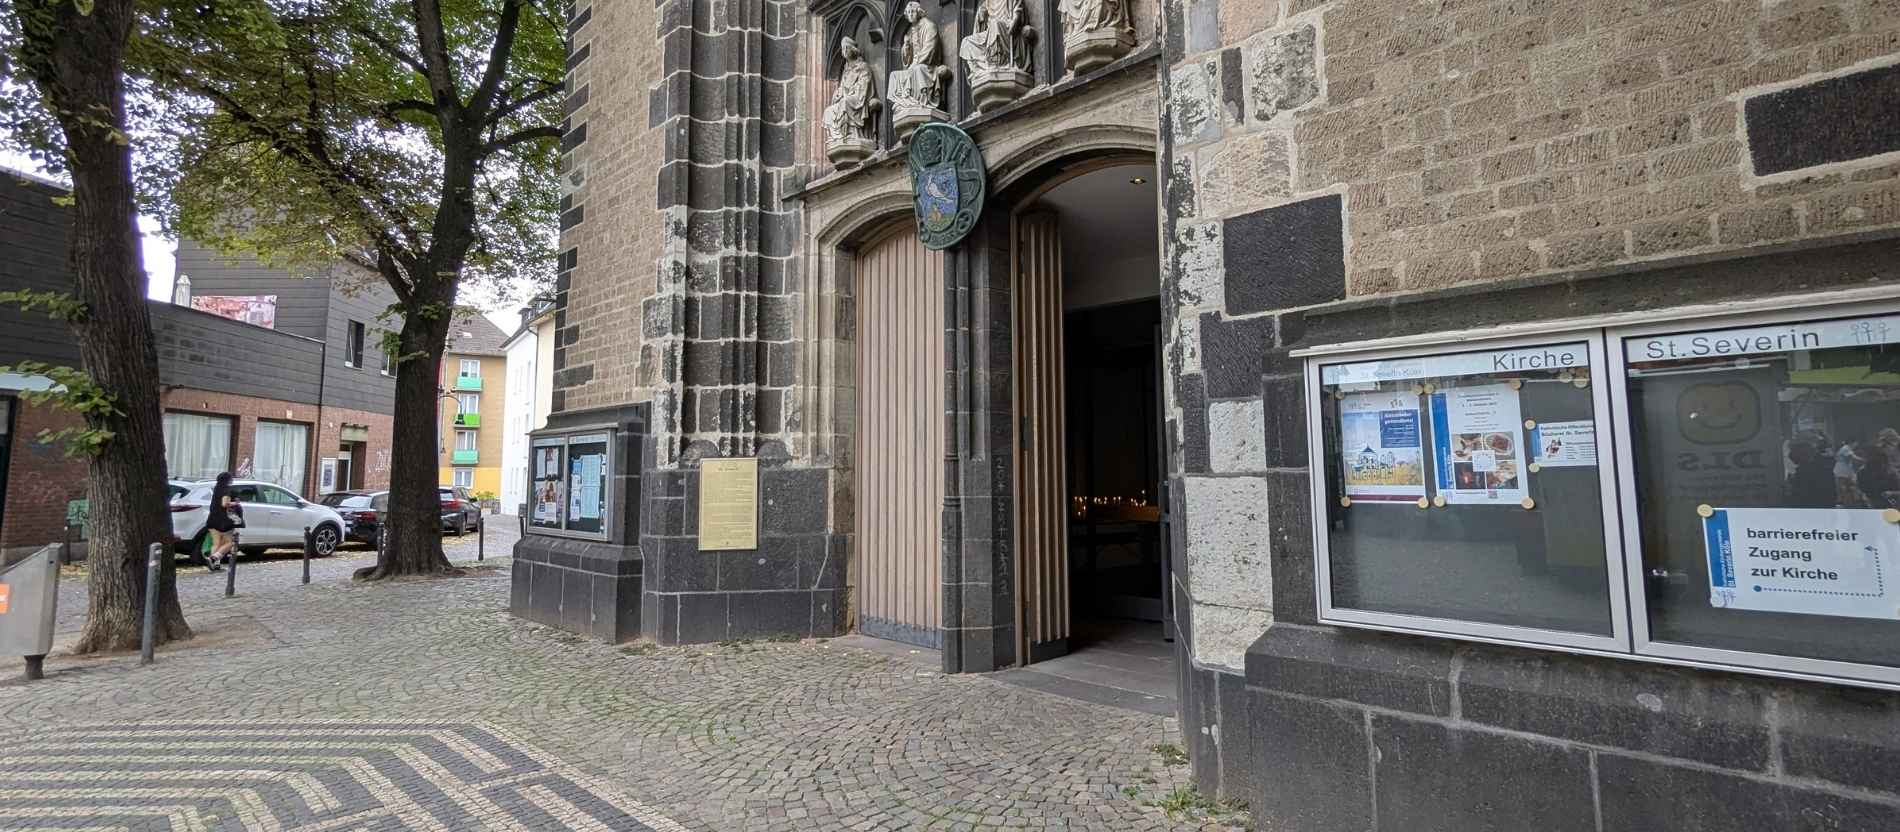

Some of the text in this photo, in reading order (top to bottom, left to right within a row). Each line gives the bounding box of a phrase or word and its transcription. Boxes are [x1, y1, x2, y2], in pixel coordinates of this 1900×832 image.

[1492, 349, 1576, 372] Kirche
[1746, 527, 1859, 541] barrierefreier
[1748, 546, 1812, 562] Zugang
[1751, 566, 1838, 580] zur Kirche
